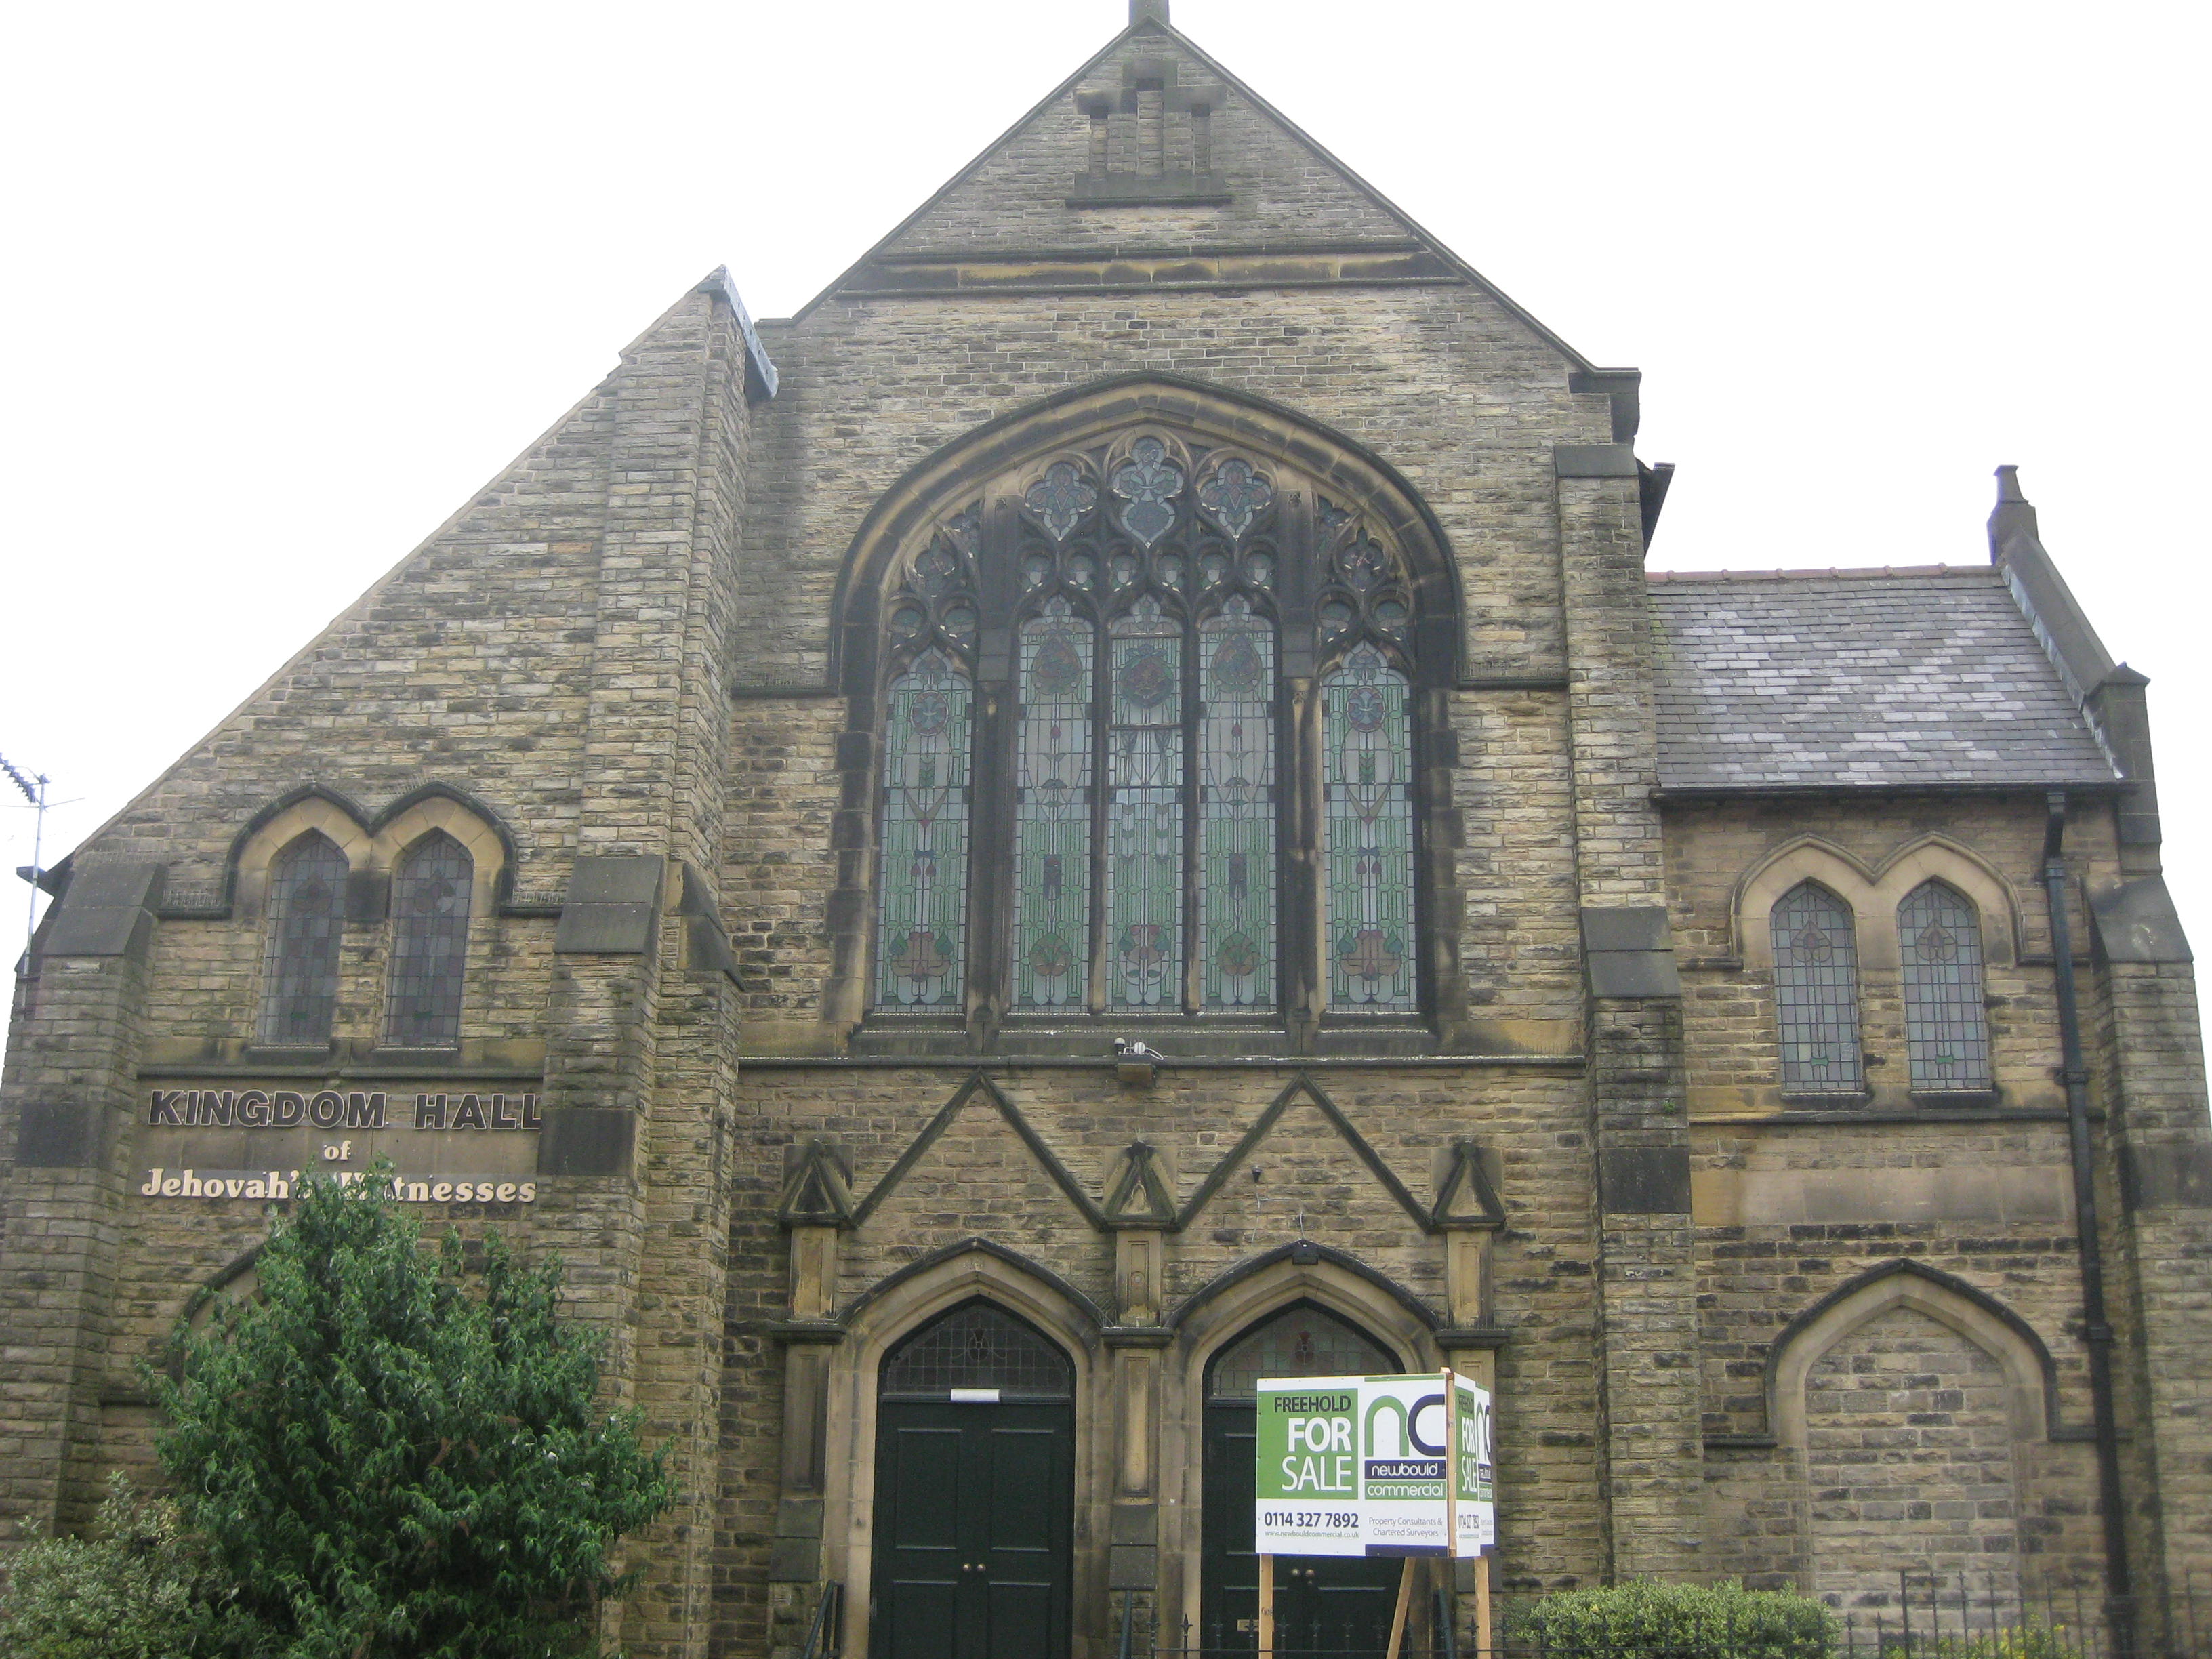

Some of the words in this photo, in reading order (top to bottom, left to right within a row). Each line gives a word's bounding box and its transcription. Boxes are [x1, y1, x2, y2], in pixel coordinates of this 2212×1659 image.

[148, 1089, 386, 1129] KINGDOM
[414, 1092, 541, 1130] HALL
[324, 1139, 352, 1160] of
[1274, 1395, 1351, 1413] FREEHOLD
[1288, 1417, 1352, 1452] FOR
[1462, 1416, 1475, 1454] FOR
[1282, 1456, 1353, 1492] SALE
[1371, 1462, 1439, 1477] newbould
[1462, 1456, 1477, 1492] SALE
[1367, 1483, 1443, 1497] commercial
[1264, 1512, 1293, 1527] 0114
[1296, 1512, 1321, 1528] 327
[1324, 1513, 1359, 1528] 7892
[1368, 1517, 1396, 1528] Property
[1397, 1517, 1436, 1526] Consultants
[1437, 1518, 1443, 1526] &
[1265, 1530, 1359, 1538] www.newbouldcommercial.co.uk
[1373, 1528, 1405, 1536] Chartered
[1406, 1528, 1439, 1538] Surveyors
